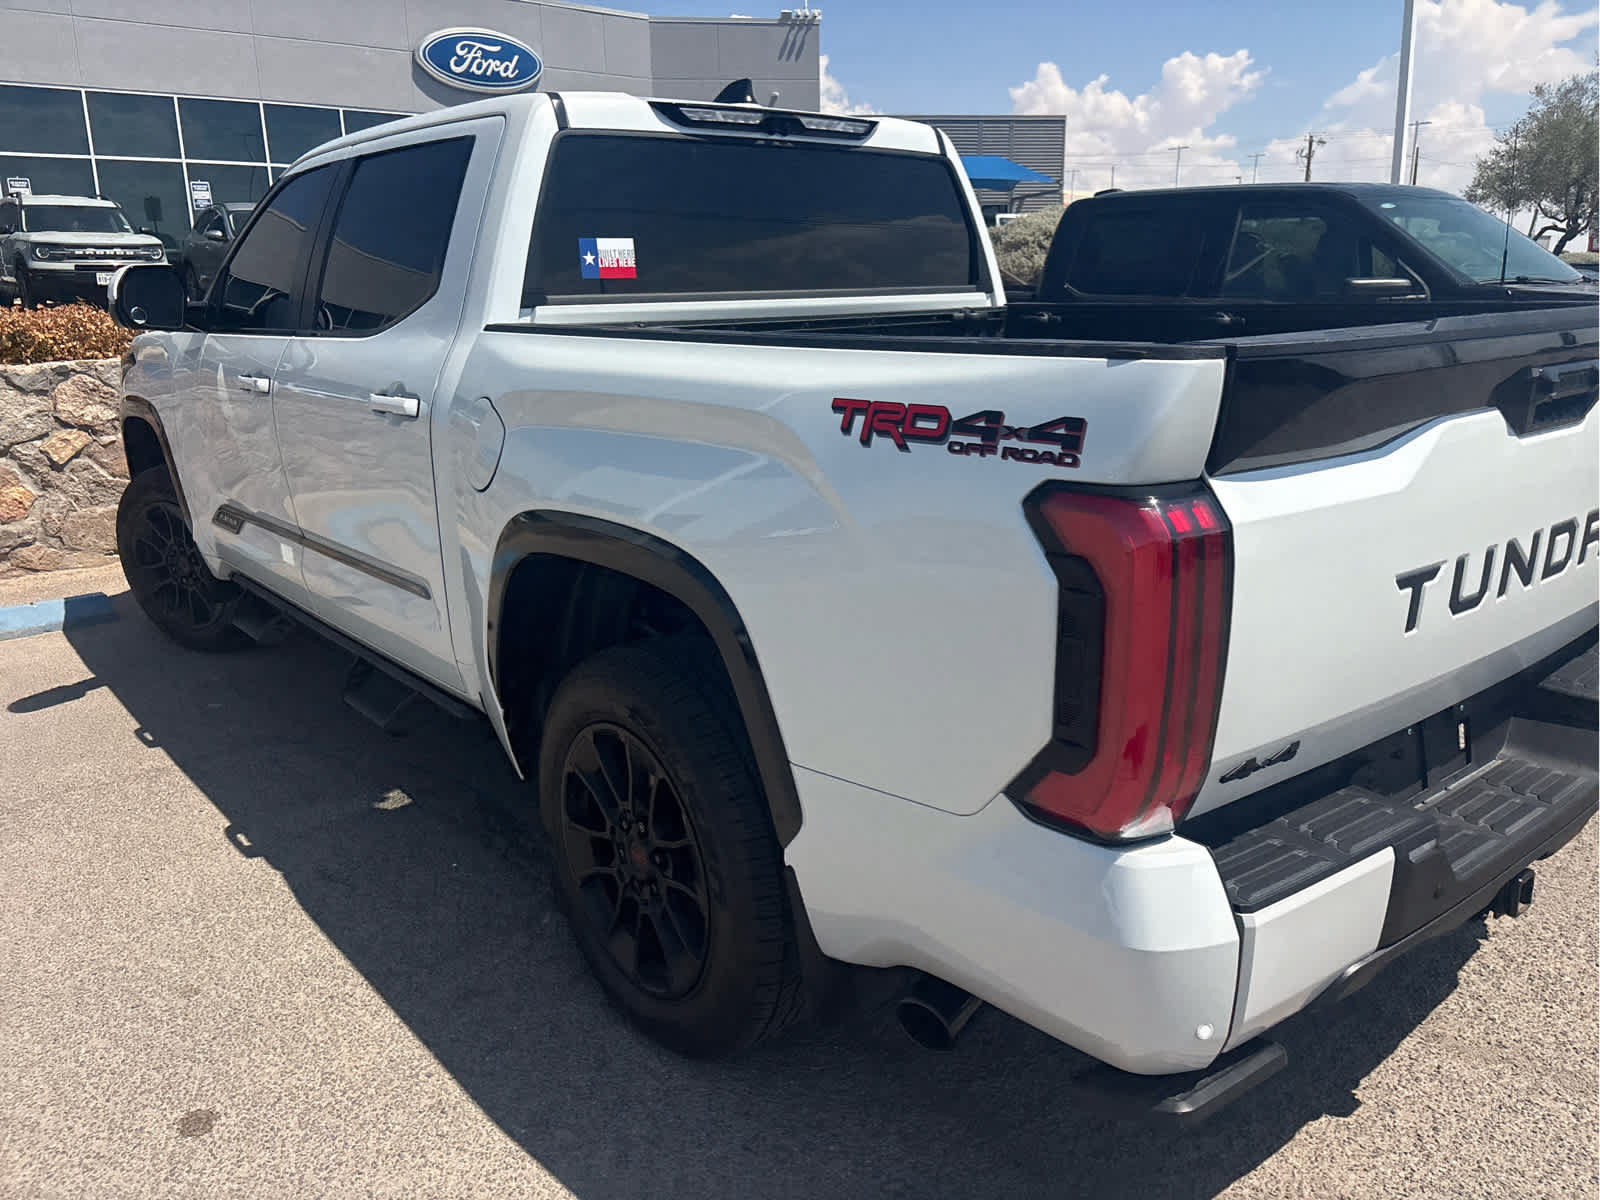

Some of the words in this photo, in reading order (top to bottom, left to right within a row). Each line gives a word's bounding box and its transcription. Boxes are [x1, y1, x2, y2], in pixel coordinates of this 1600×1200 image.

[449, 40, 519, 79] Ford
[618, 258, 636, 267] HERE
[831, 397, 952, 453] TRD
[947, 440, 999, 458] OFF
[1001, 446, 1082, 469] ROAD
